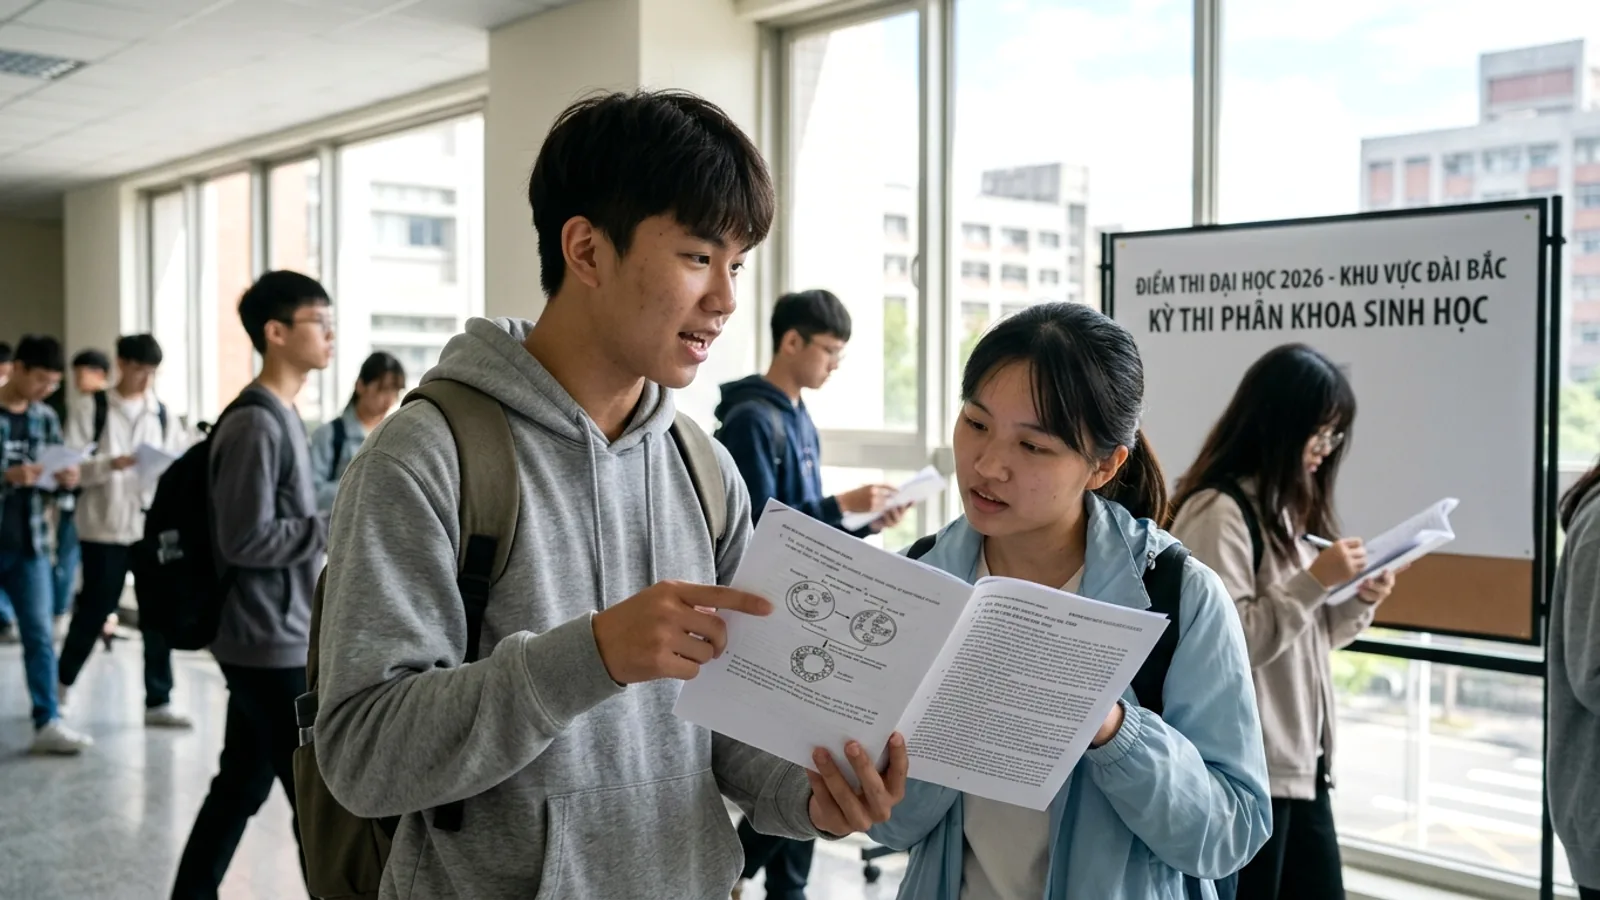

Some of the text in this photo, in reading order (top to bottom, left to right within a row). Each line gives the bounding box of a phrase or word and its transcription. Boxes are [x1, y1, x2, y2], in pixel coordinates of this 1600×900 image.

[1180, 274, 1204, 293] THI
[1242, 270, 1276, 296] HỌC
[1280, 268, 1324, 289] 2026
[1340, 264, 1378, 286] KHU
[1384, 259, 1422, 289] VỰC
[1427, 255, 1460, 282] ĐÀI
[1467, 250, 1507, 280] BẮC
[1149, 295, 1488, 333] KỲ THI PHÂN KHOA SINH HỌC
